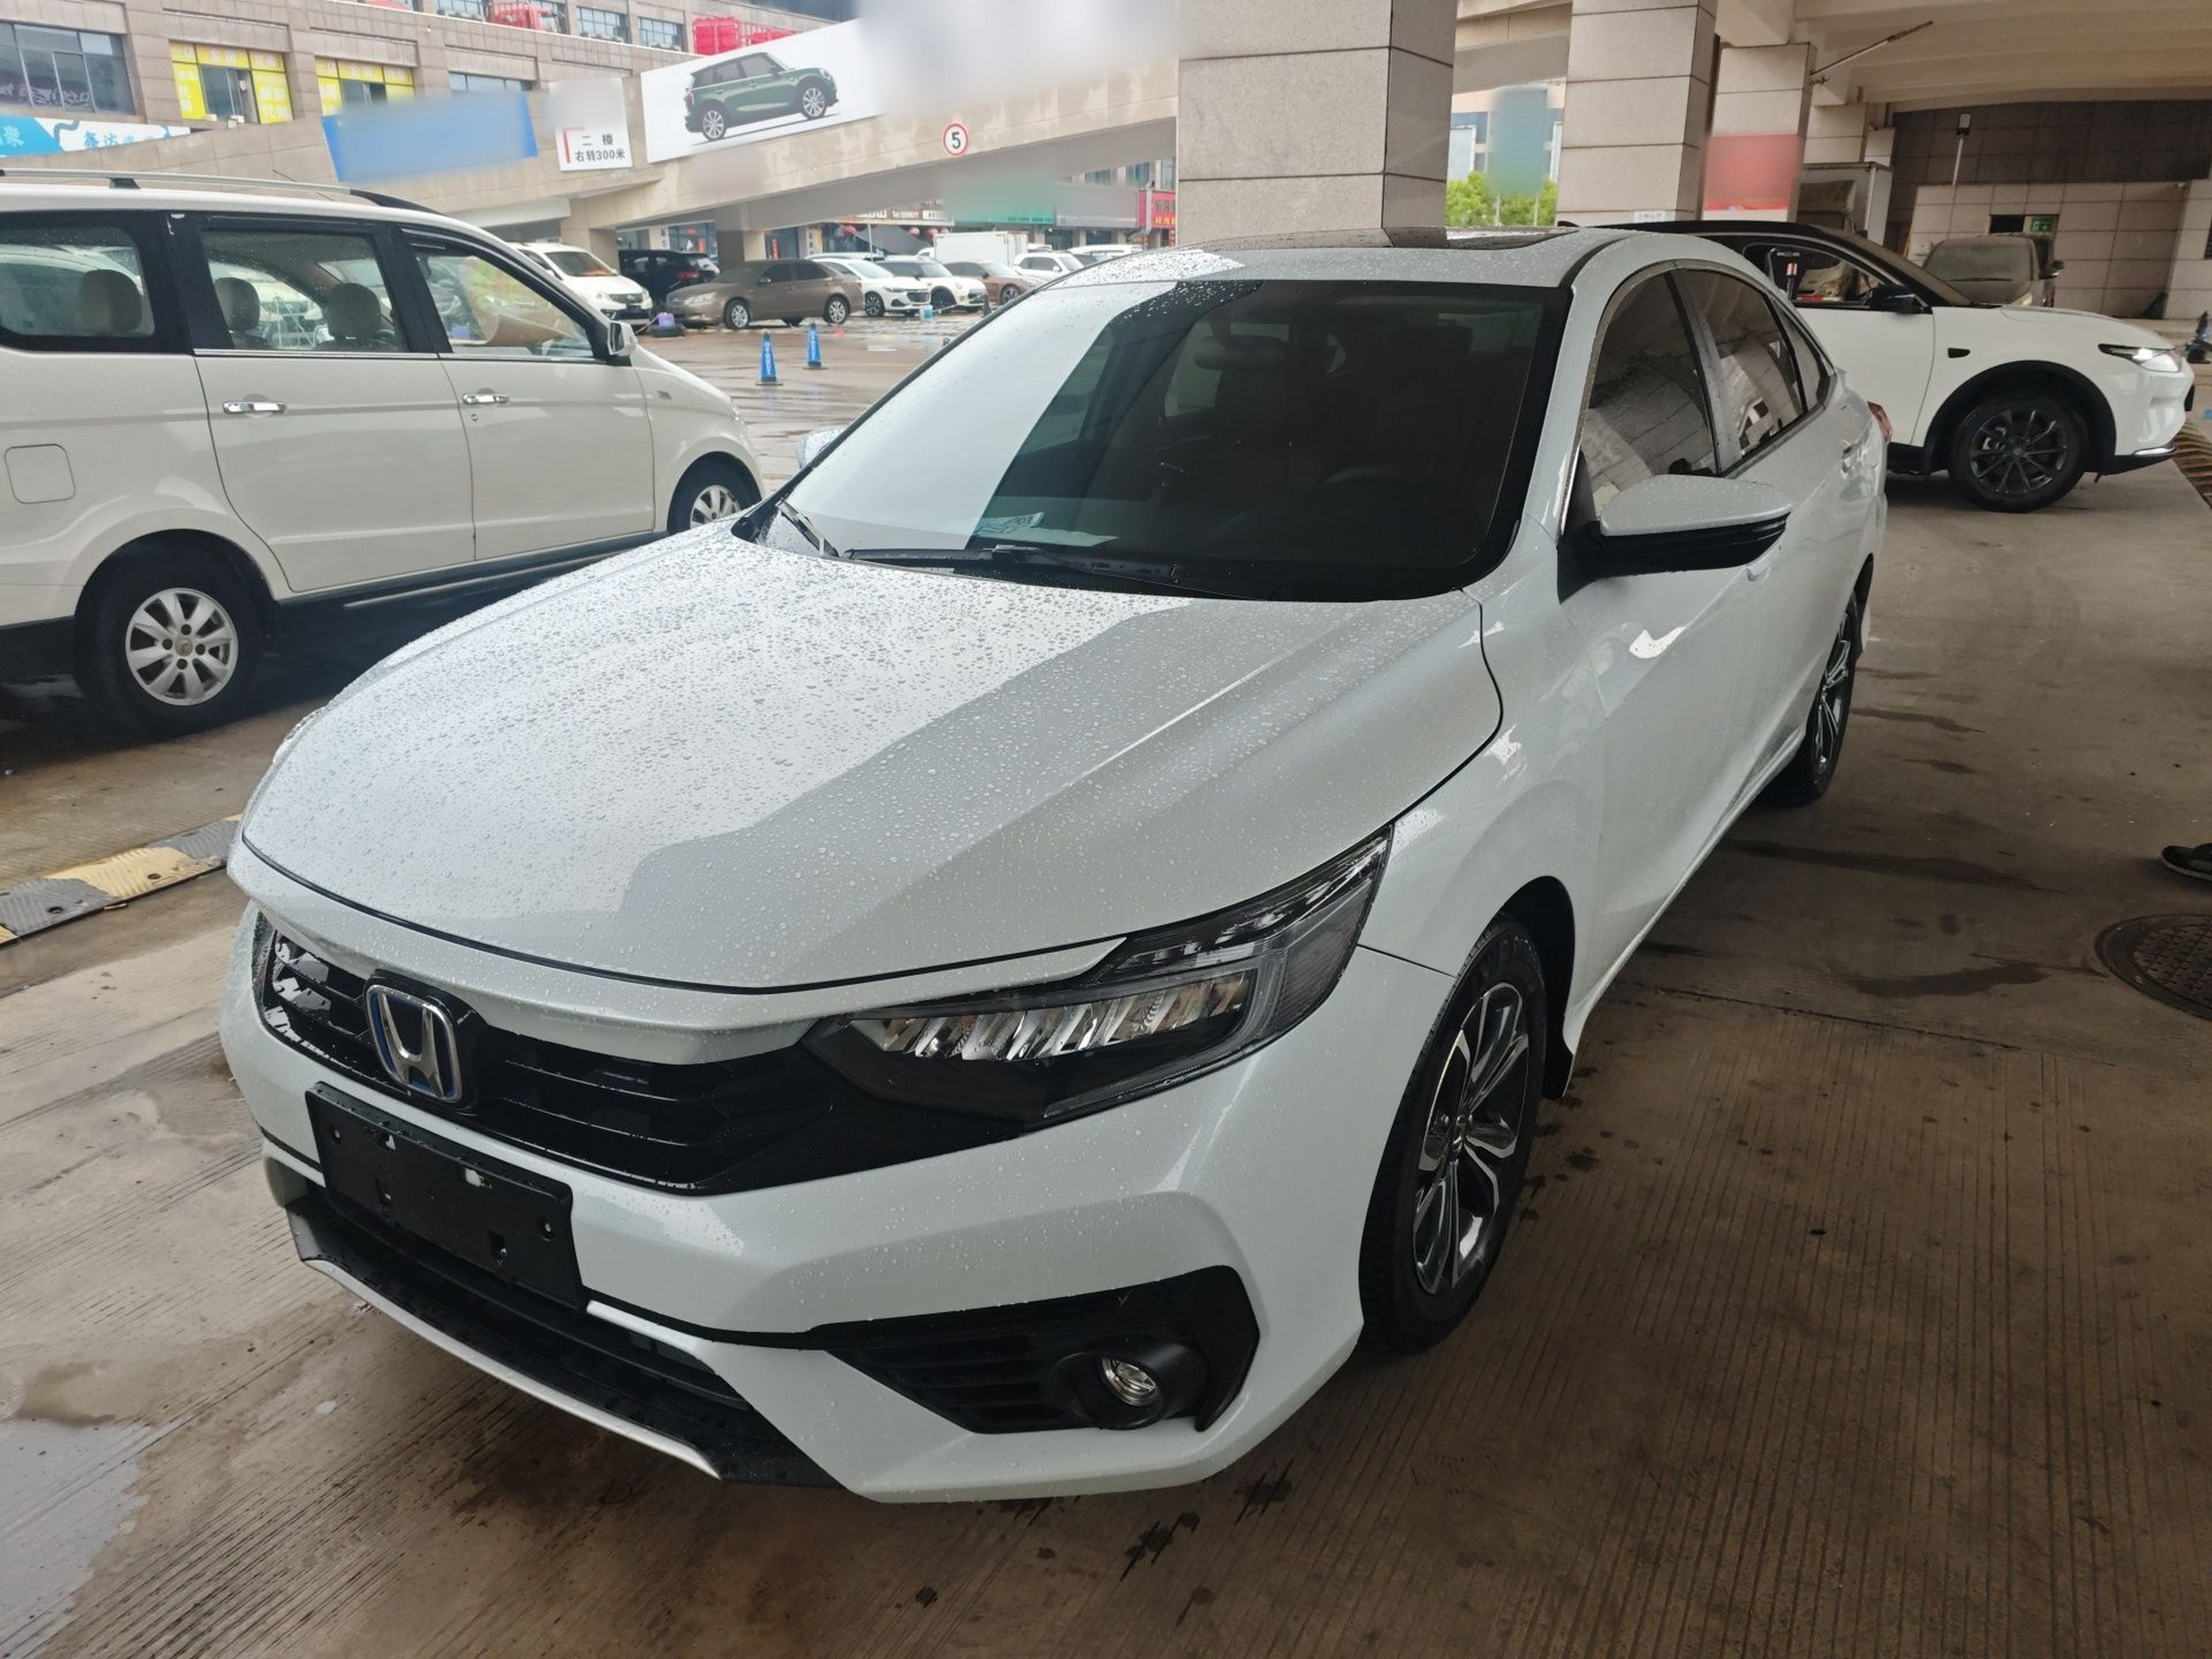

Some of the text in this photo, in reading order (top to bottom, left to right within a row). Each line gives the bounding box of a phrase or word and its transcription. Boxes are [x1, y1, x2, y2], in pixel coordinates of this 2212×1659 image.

[952, 132, 961, 149] 5
[575, 149, 626, 162] 右转300米
